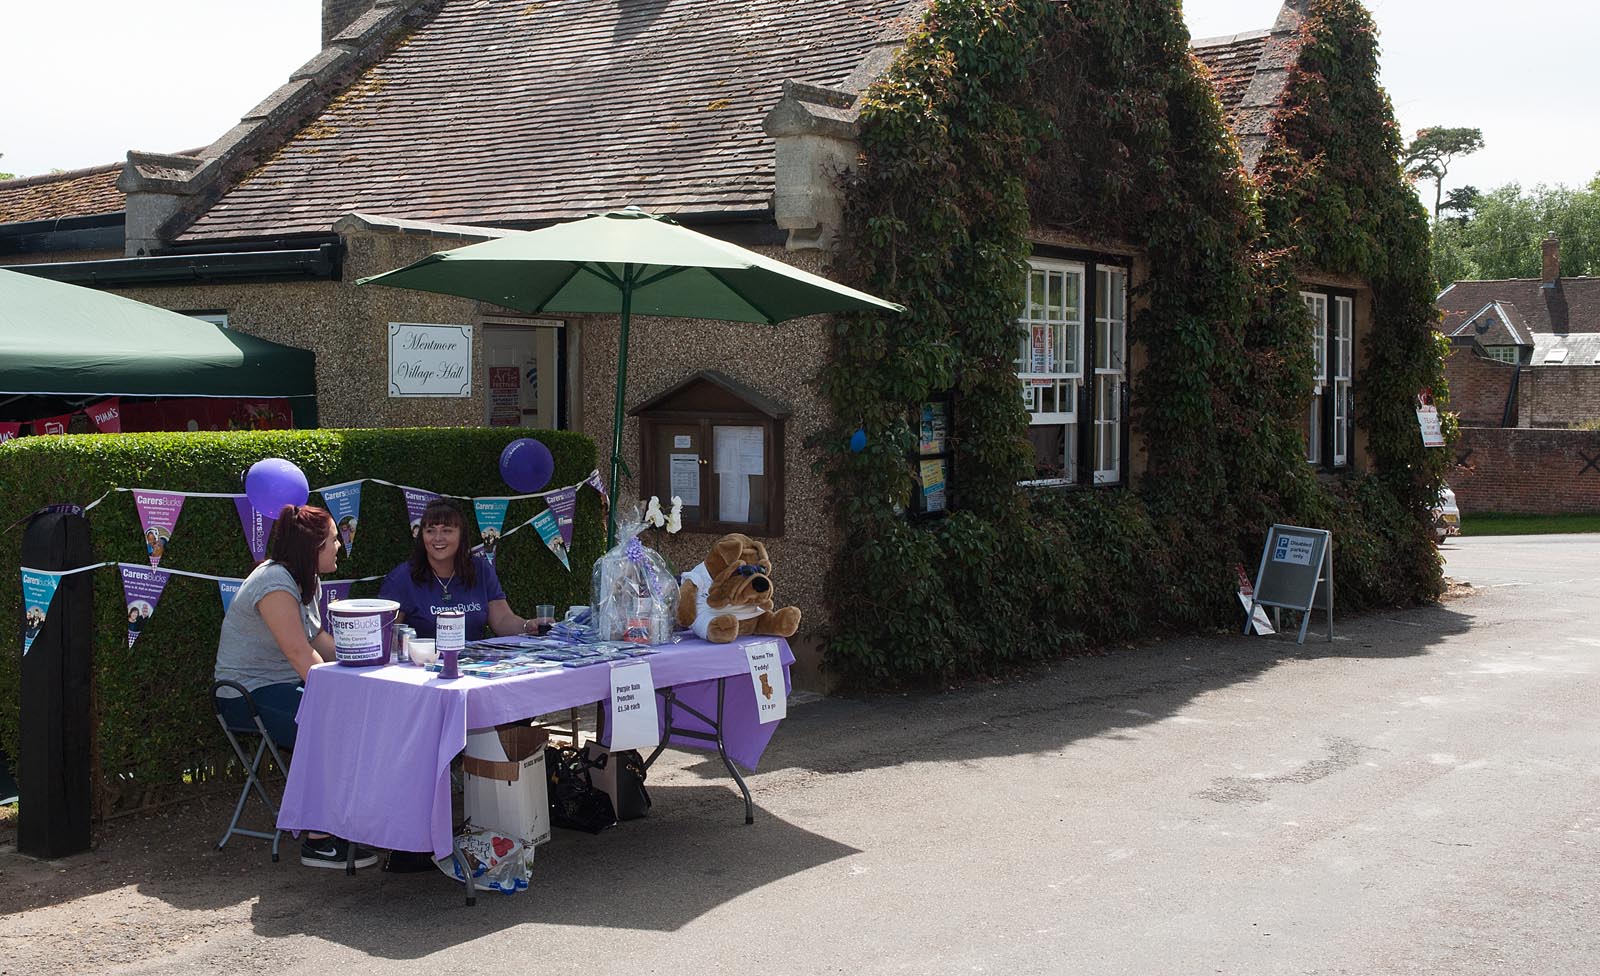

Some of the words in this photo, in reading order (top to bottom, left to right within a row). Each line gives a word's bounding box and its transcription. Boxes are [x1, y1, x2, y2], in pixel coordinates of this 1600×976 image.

[402, 331, 457, 351] Mentmore
[397, 360, 435, 385] Village
[437, 360, 464, 379] Hall
[95, 407, 119, 425] PIMM'S
[137, 495, 182, 507] CarersBucks
[1290, 540, 1313, 548] Disabled
[1290, 547, 1309, 555] parking
[123, 568, 167, 583] CarersBucks
[616, 685, 631, 694] Purple
[630, 702, 640, 710] each
